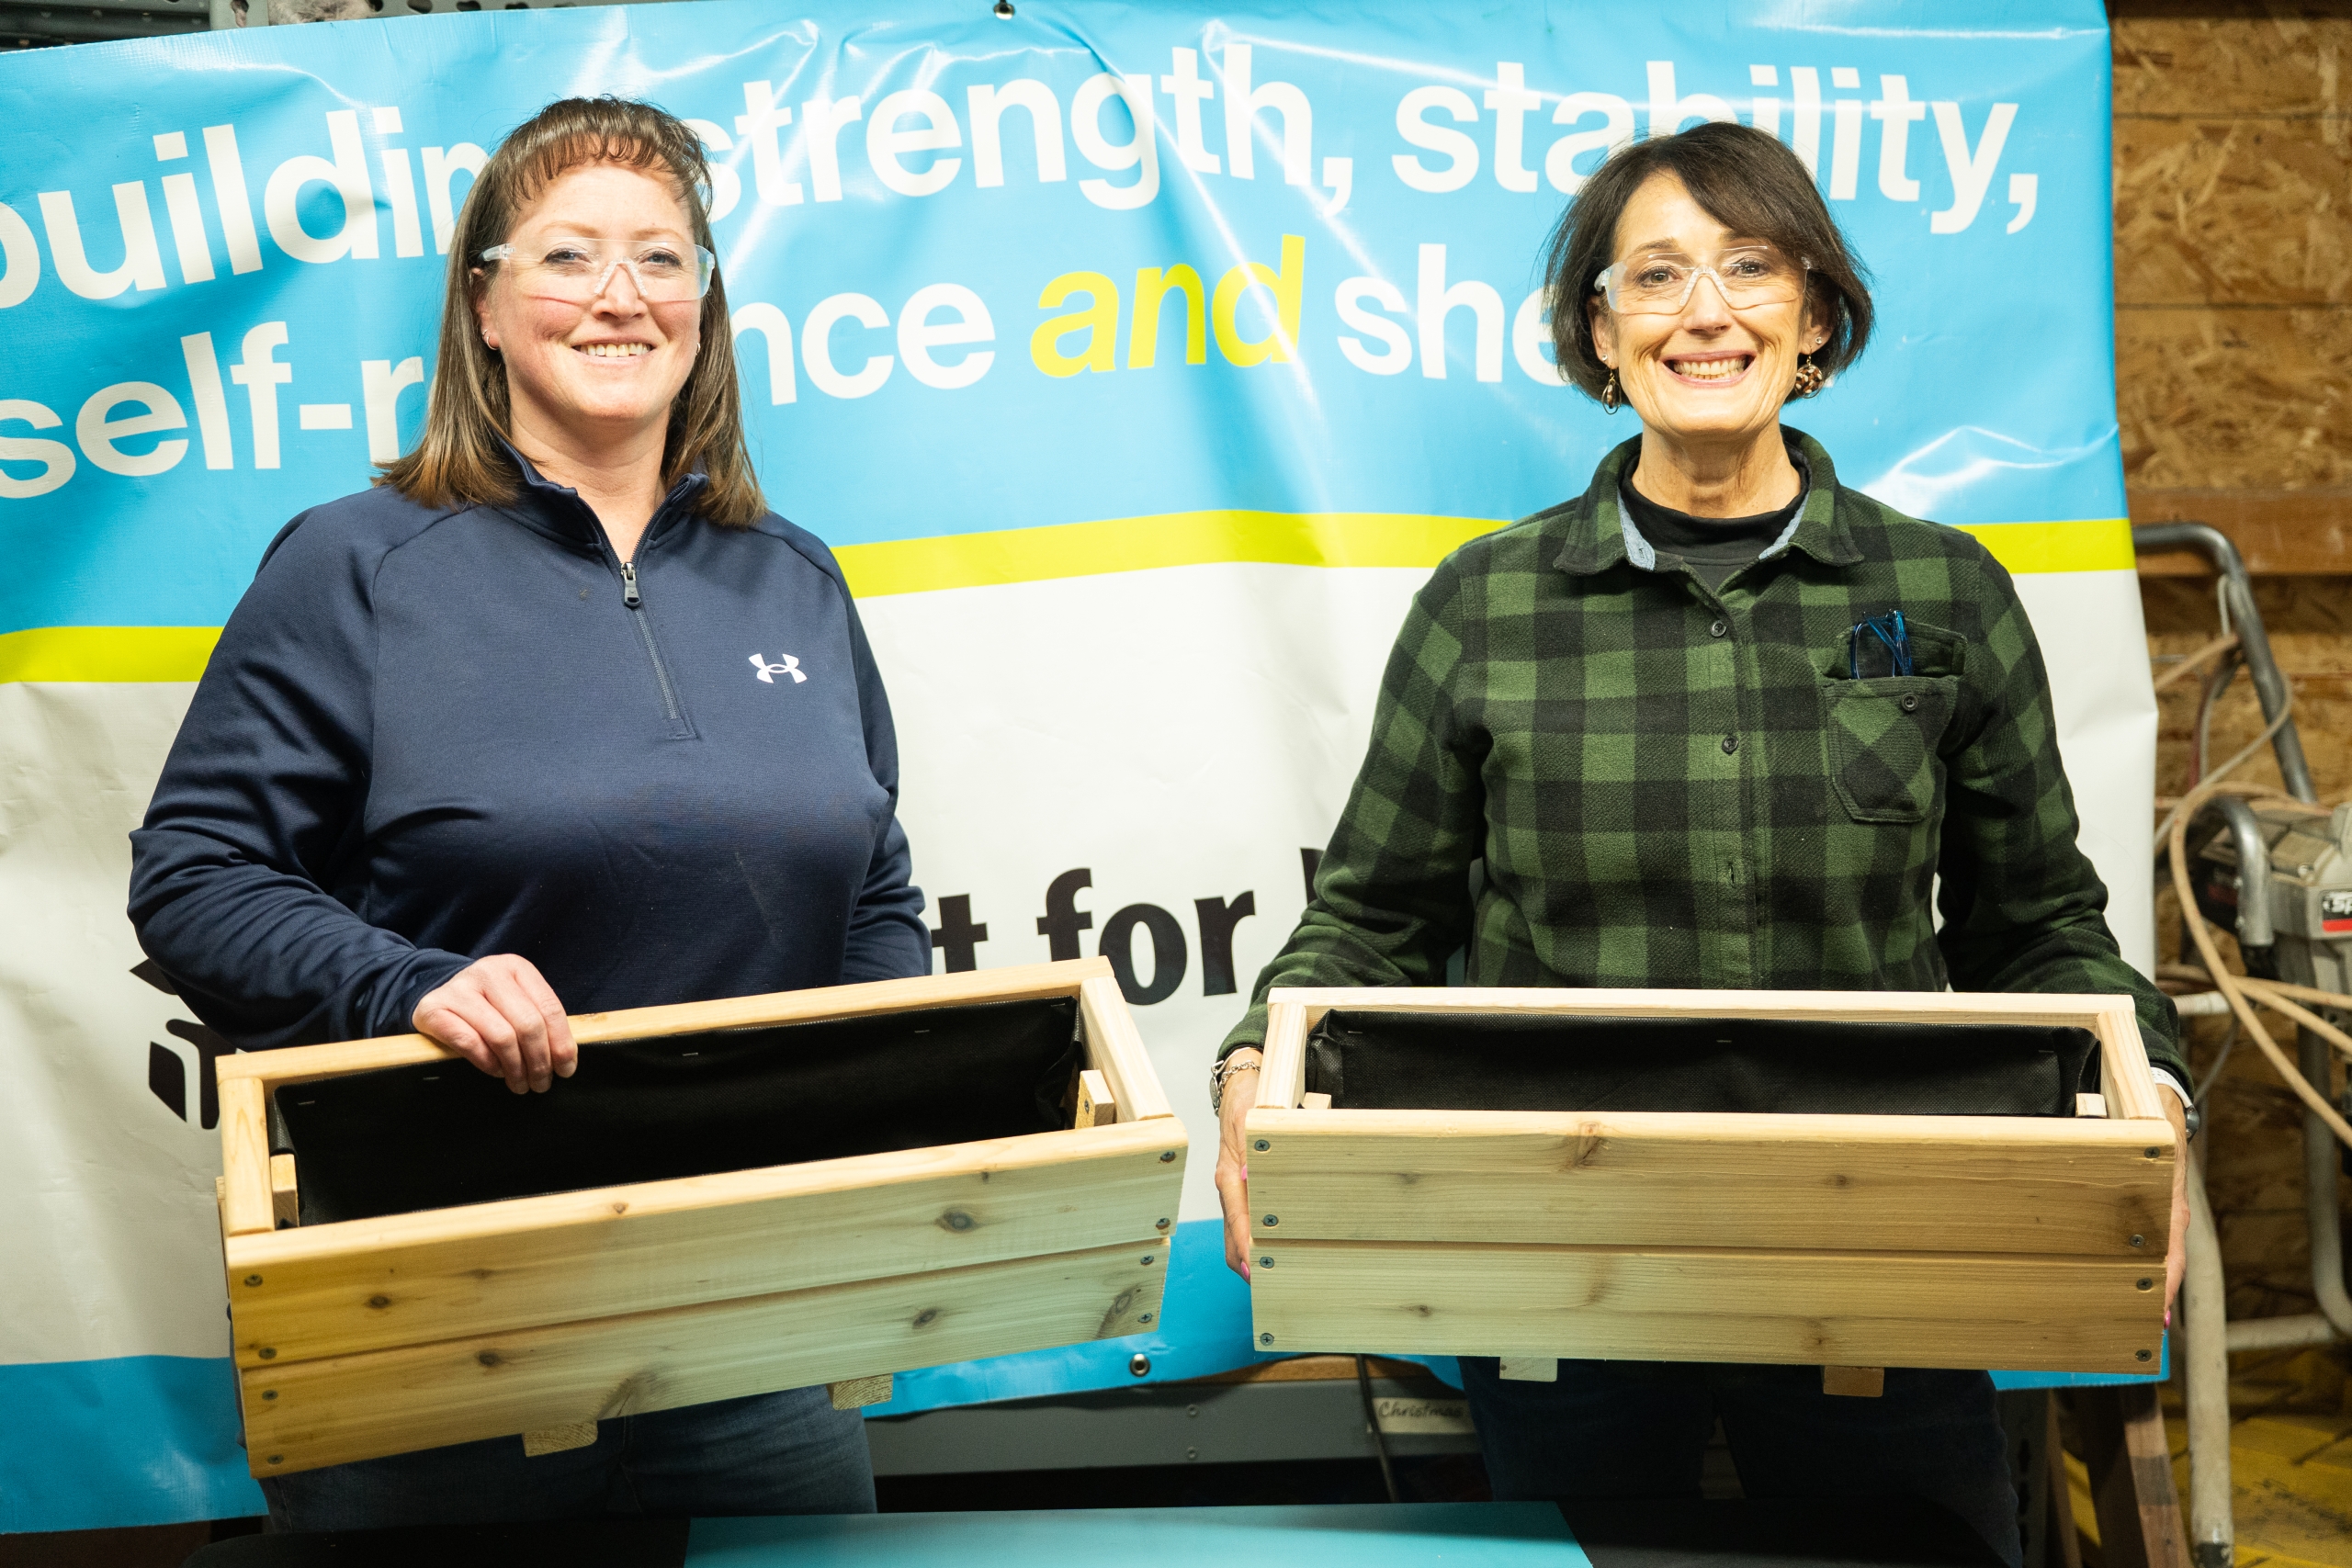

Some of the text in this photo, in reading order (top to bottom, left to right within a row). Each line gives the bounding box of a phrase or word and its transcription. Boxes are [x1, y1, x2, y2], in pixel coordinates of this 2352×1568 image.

[0, 106, 488, 309] uildin
[678, 44, 1353, 223] strength,
[1030, 233, 1306, 378] and
[1036, 868, 1255, 1006] for
[1378, 1401, 1463, 1418] Christmas
